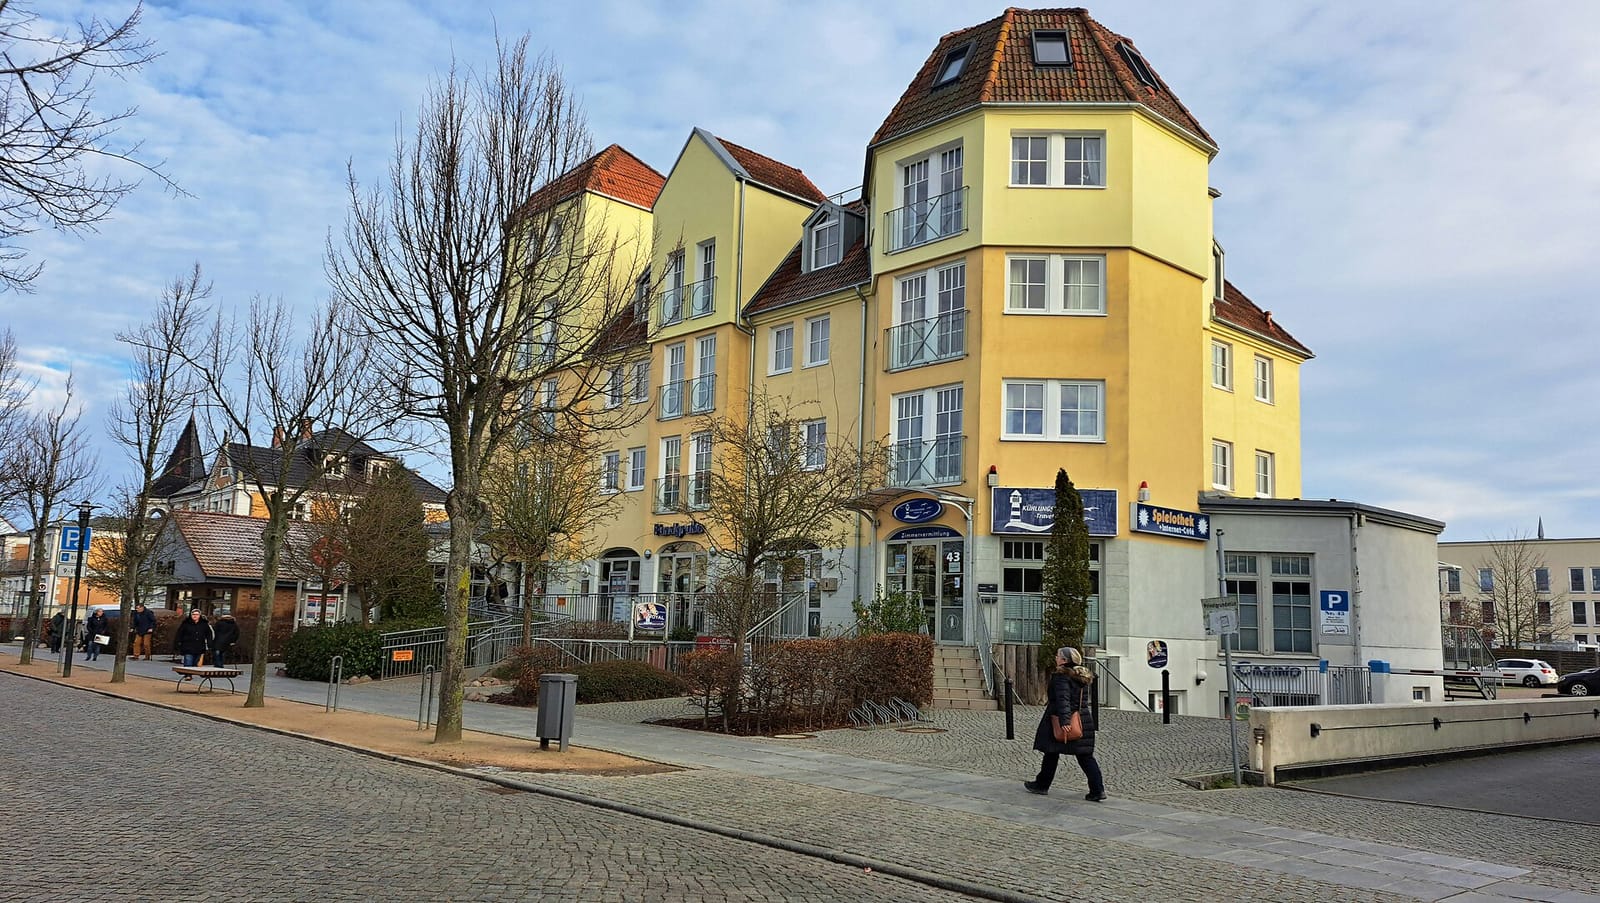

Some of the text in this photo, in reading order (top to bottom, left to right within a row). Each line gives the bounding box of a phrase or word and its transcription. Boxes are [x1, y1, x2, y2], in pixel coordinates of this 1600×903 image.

[1022, 503, 1057, 512] KÜHLUNGS
[1152, 509, 1195, 527] Spielothek
[66, 529, 81, 548] P
[946, 551, 961, 562] 43
[1328, 594, 1342, 609] P
